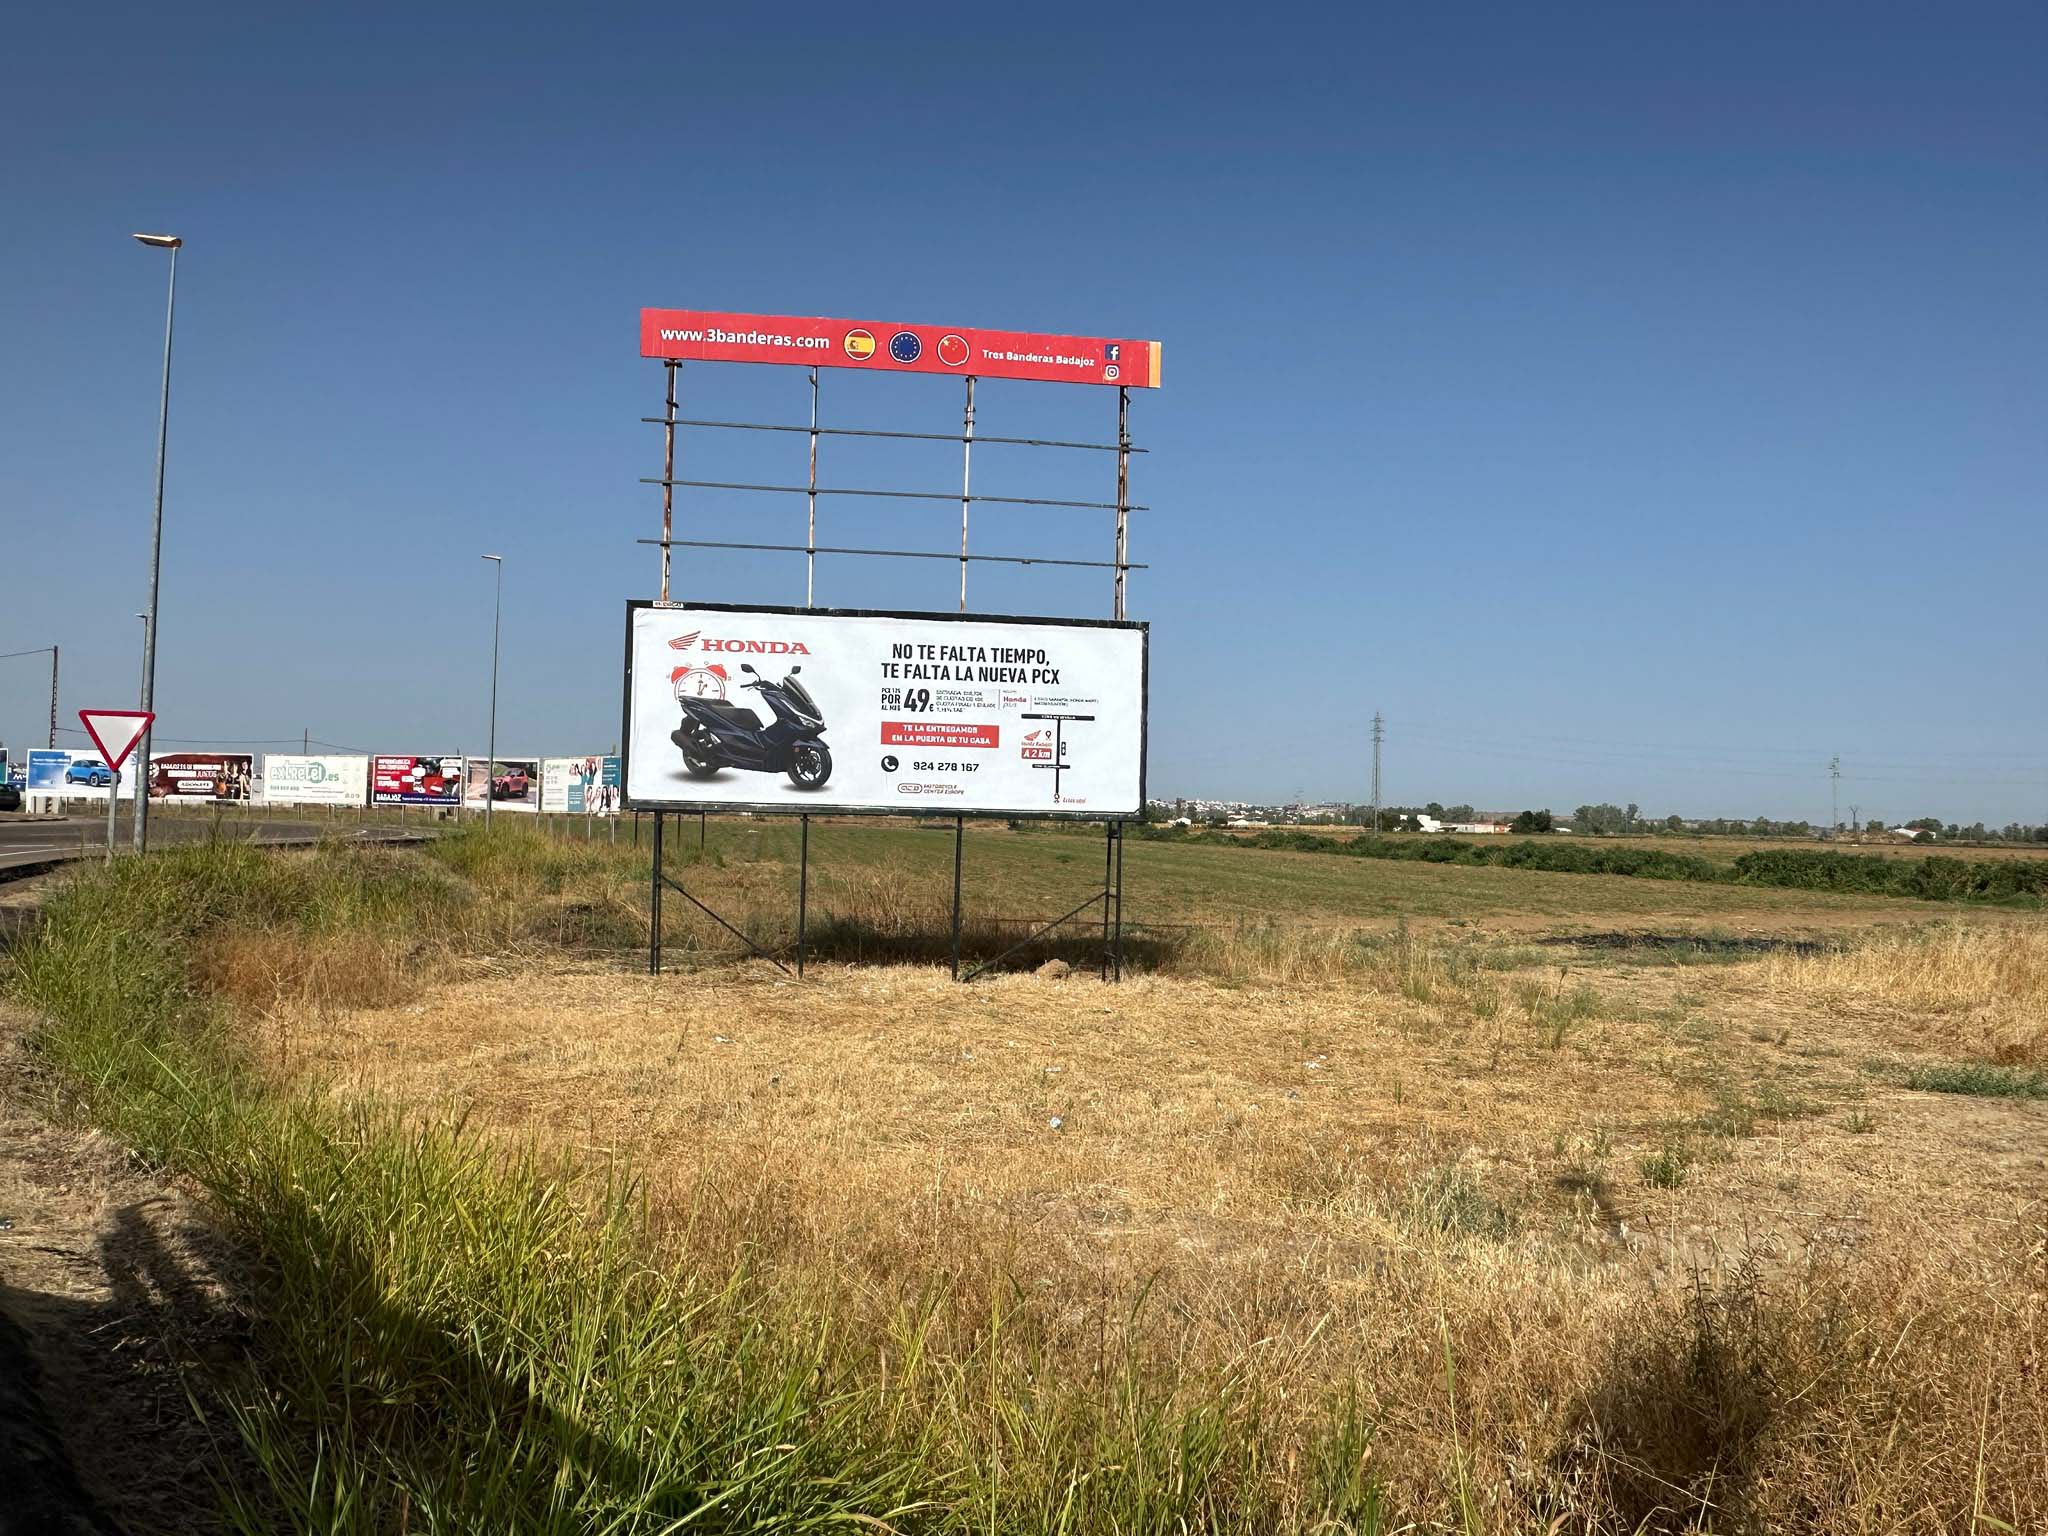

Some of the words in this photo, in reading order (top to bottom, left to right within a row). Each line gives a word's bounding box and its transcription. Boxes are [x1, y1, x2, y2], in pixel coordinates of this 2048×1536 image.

[660, 326, 830, 350] www.3banderas.com
[982, 349, 1004, 361] Tres
[1005, 350, 1054, 364] Banderas
[1056, 353, 1095, 368] Badajoz
[700, 638, 811, 655] HONDA
[892, 643, 912, 660] NO
[917, 644, 935, 660] TE
[940, 645, 986, 663] FALTA
[990, 647, 1050, 666] TIEMPO,
[881, 662, 899, 679] TE
[904, 663, 950, 681] FALTA
[955, 666, 974, 682] LA
[979, 667, 1027, 684] NUEVA
[1032, 669, 1060, 685] PCX
[881, 693, 901, 704] POR
[926, 725, 977, 734] ENTREGAMOS
[1023, 749, 1030, 758] A
[1031, 750, 1037, 758] 2
[1038, 750, 1051, 758] km
[913, 761, 934, 771] 924
[937, 762, 958, 772] 278
[961, 762, 980, 773] 167
[376, 793, 402, 801] BADAJOZ
